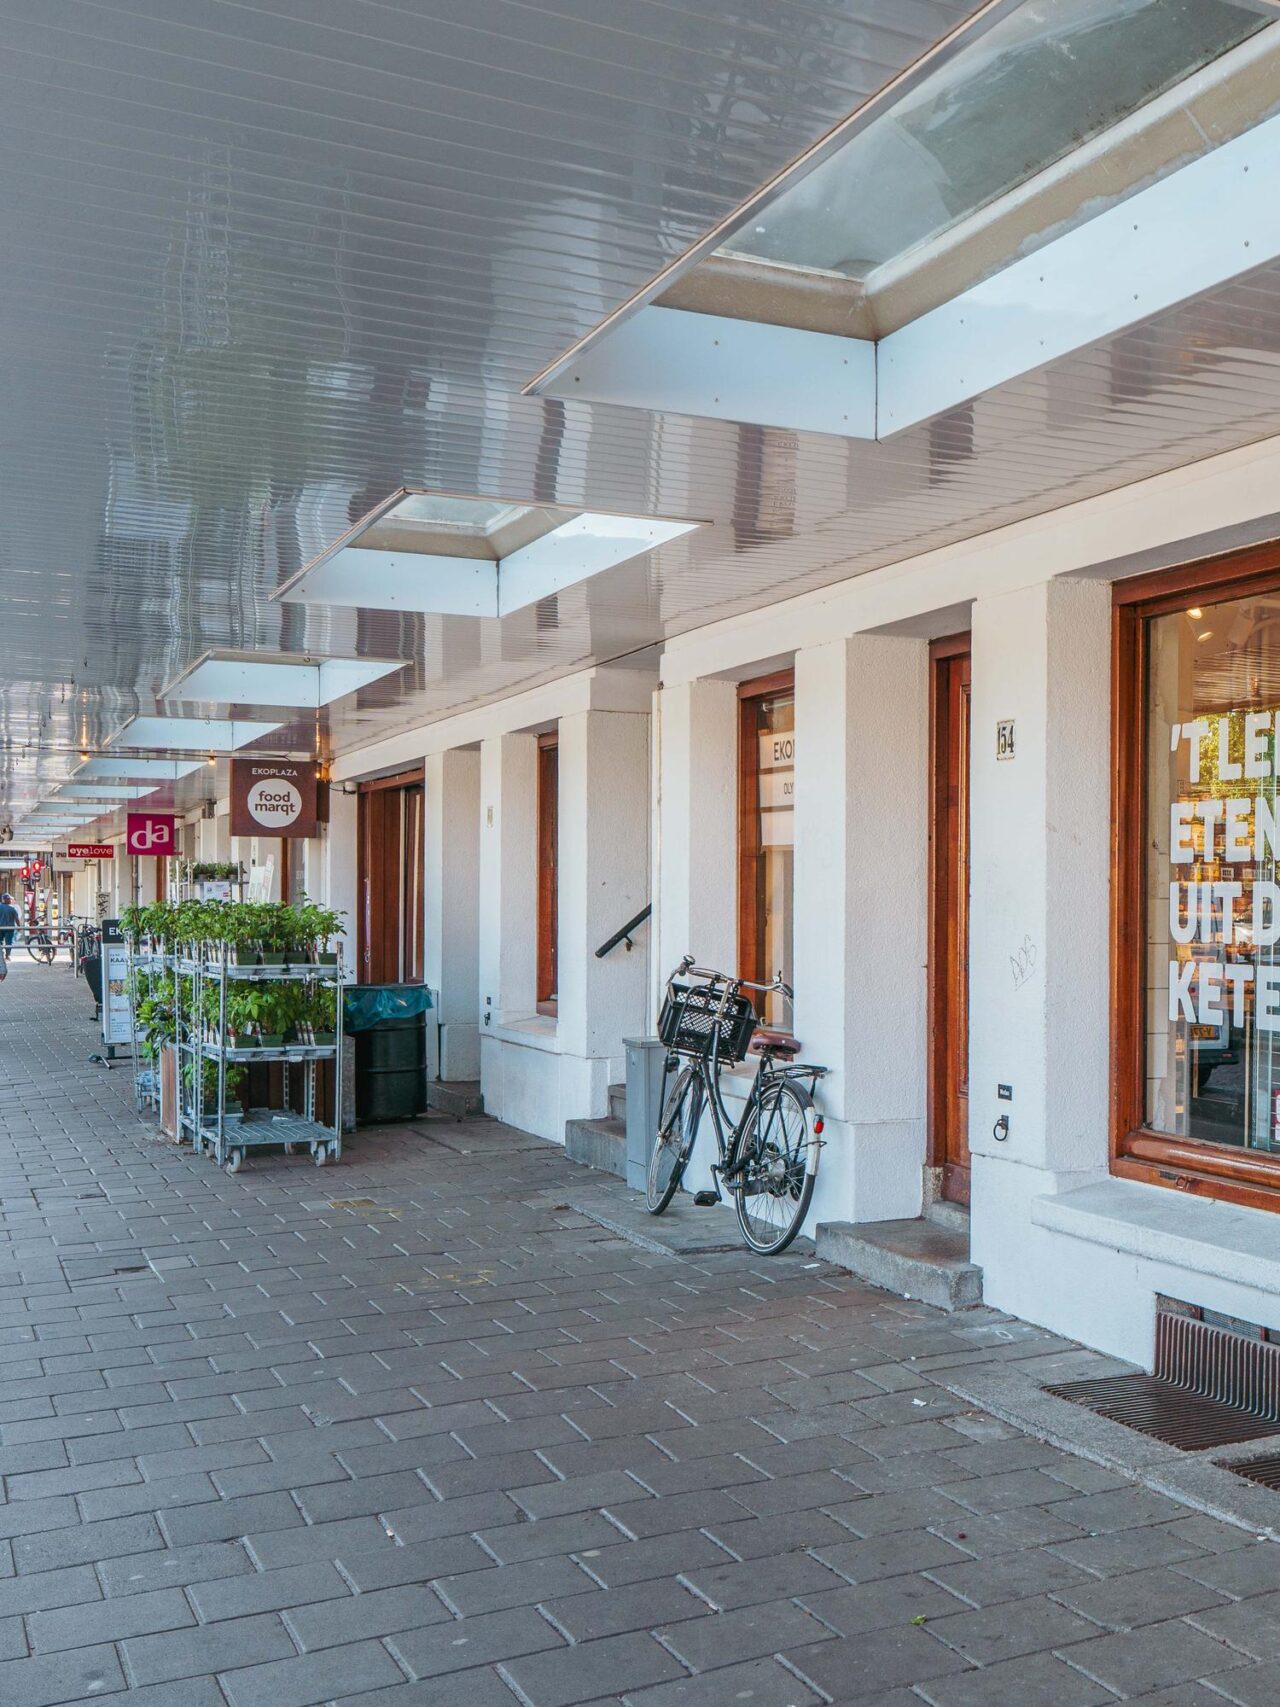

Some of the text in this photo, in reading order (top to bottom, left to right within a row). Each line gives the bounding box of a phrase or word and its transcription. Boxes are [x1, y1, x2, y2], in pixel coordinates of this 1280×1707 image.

[1170, 719, 1209, 783] 'T
[251, 767, 298, 777] EKOPLAZA
[258, 790, 290, 803] food
[254, 802, 296, 816] marqt
[131, 820, 170, 849] da
[1169, 881, 1243, 945] UIT
